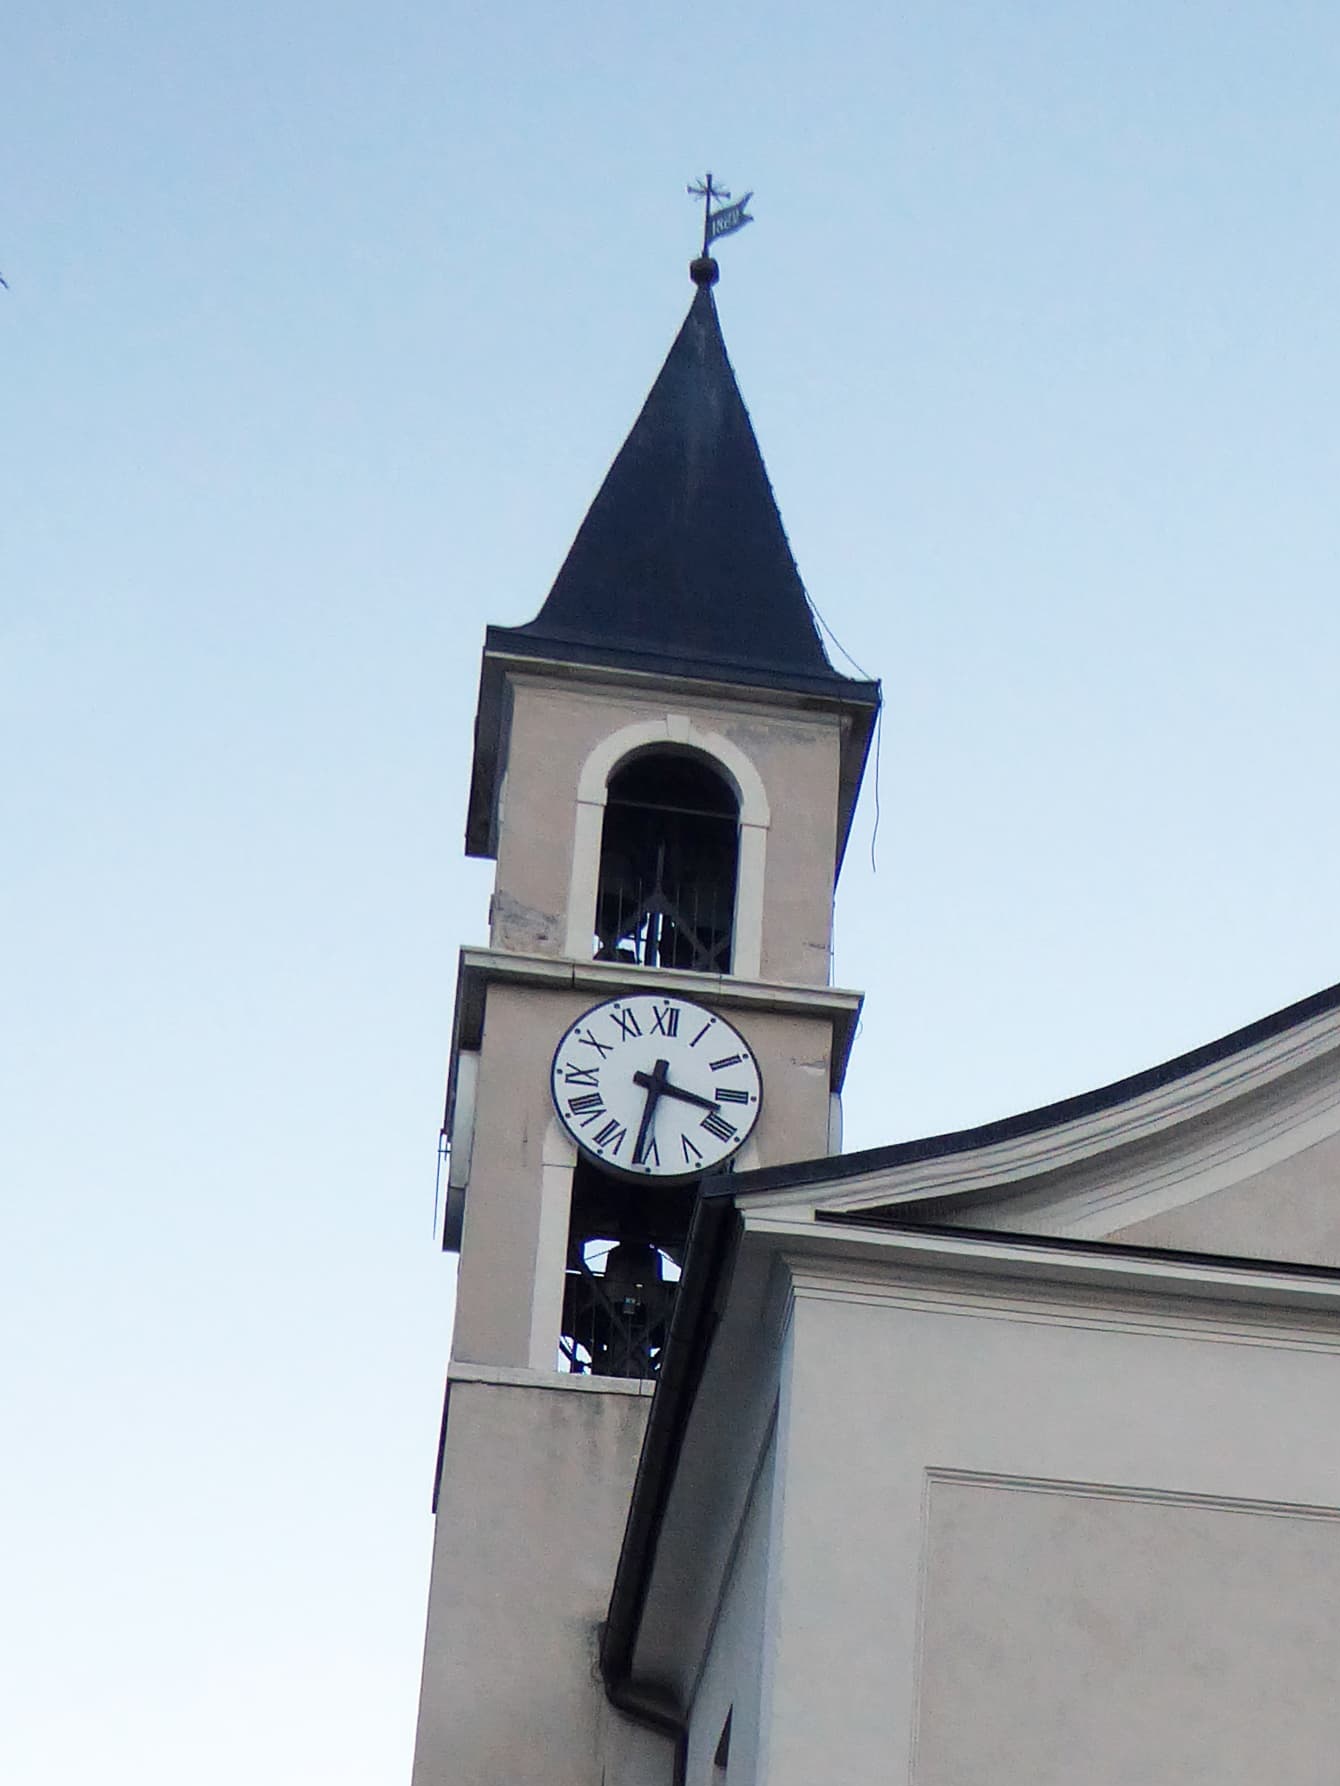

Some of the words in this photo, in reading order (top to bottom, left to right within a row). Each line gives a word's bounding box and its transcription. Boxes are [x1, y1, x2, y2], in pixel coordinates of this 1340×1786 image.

[610, 1008, 643, 1042] XI
[650, 1006, 680, 1037] XII
[690, 1024, 710, 1047] I
[579, 1029, 613, 1059] X
[565, 1062, 600, 1087] IX
[709, 1054, 742, 1072] II
[567, 1092, 607, 1127] VIII
[715, 1088, 749, 1105] III
[593, 1119, 627, 1155] VII
[681, 1133, 703, 1163] V
